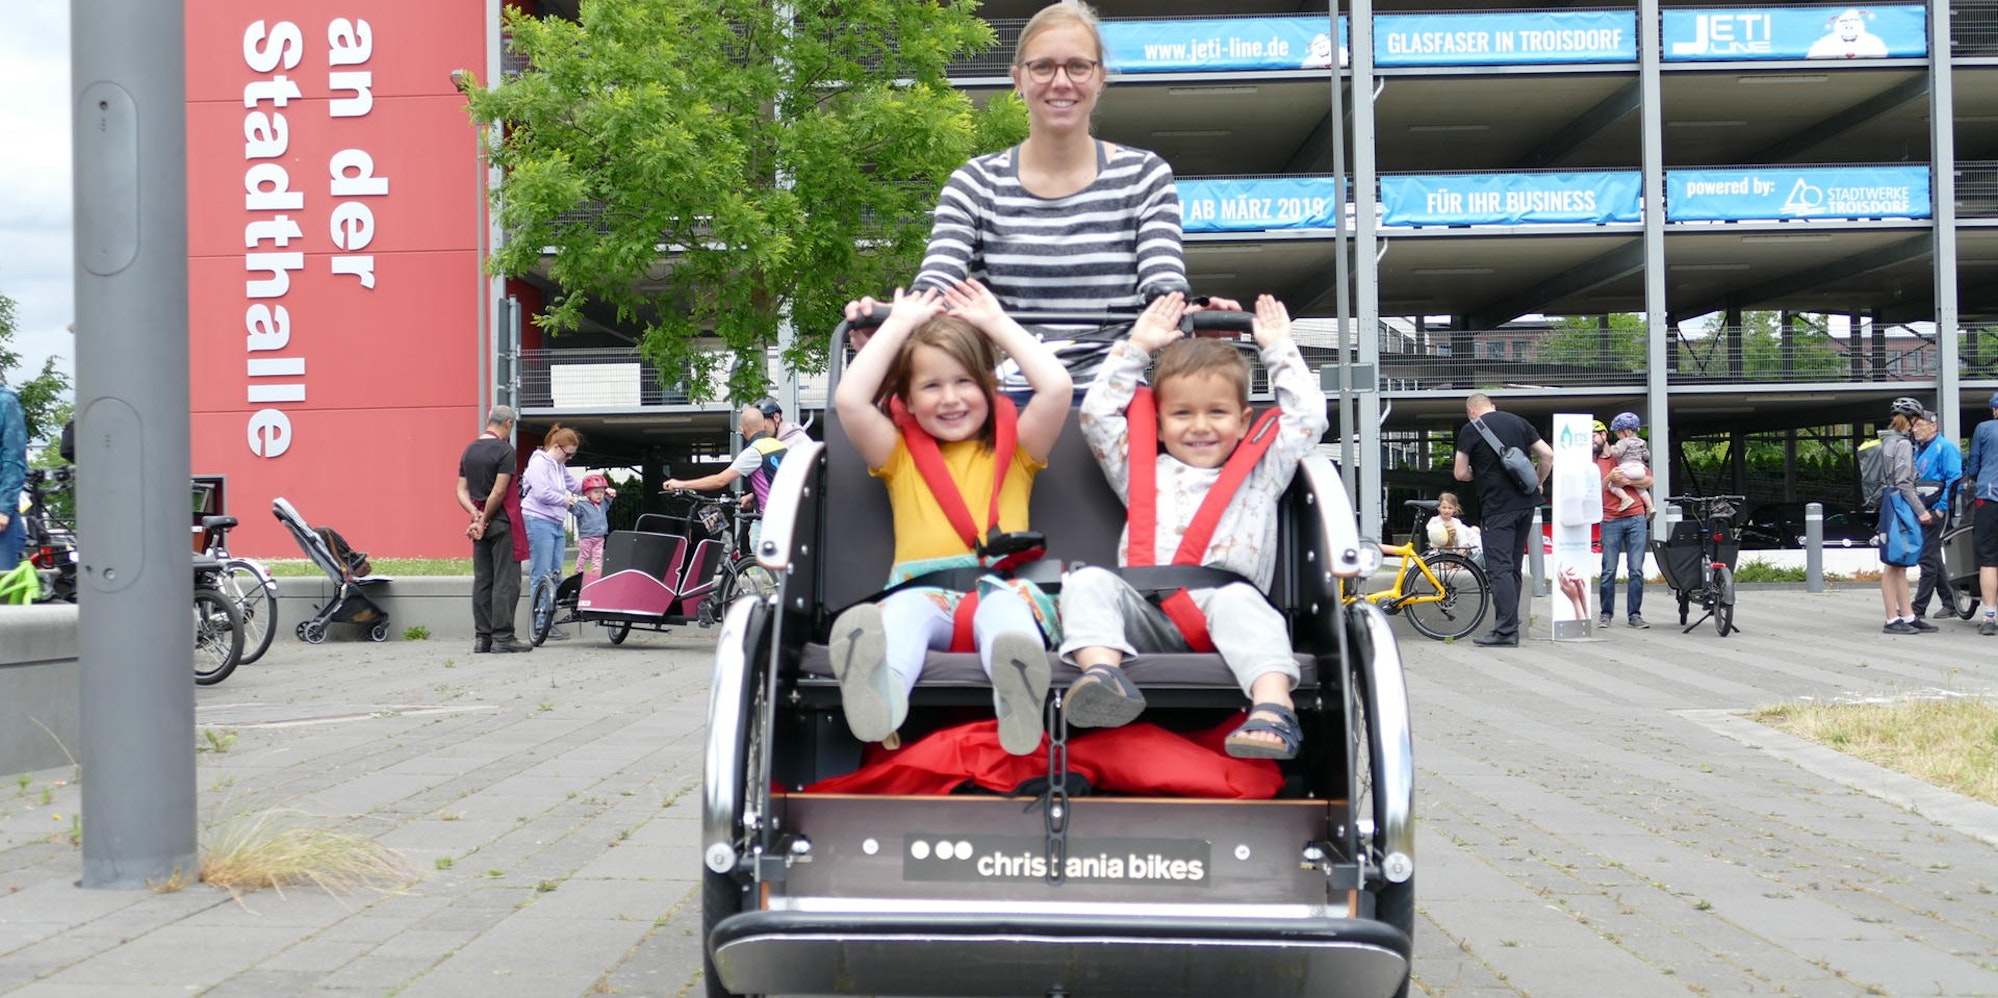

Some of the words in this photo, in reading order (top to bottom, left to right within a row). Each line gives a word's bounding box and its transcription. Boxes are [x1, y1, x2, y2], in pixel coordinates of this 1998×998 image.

[1387, 32, 1489, 54] GLASFASER
[1495, 32, 1514, 52] IN
[1519, 29, 1623, 51] TROISDORF
[1672, 14, 1771, 54] JETI
[1144, 36, 1289, 62] www.jeti-line.de
[1710, 41, 1771, 54] LINE
[327, 17, 373, 117] an
[1686, 177, 1748, 198] powered
[1753, 176, 1775, 196] by:
[1827, 186, 1909, 201] STADTWERKE
[1190, 199, 1216, 220] AB
[1220, 194, 1273, 219] MÄRZ
[1427, 189, 1462, 214] FÜR
[1468, 192, 1500, 213] IHR
[1506, 190, 1596, 212] BUSINESS
[1827, 201, 1910, 213] TROISDORF
[329, 148, 389, 289] der
[243, 19, 306, 458] Stadthalle
[977, 851, 1124, 878] christania
[1129, 855, 1205, 880] bikes
